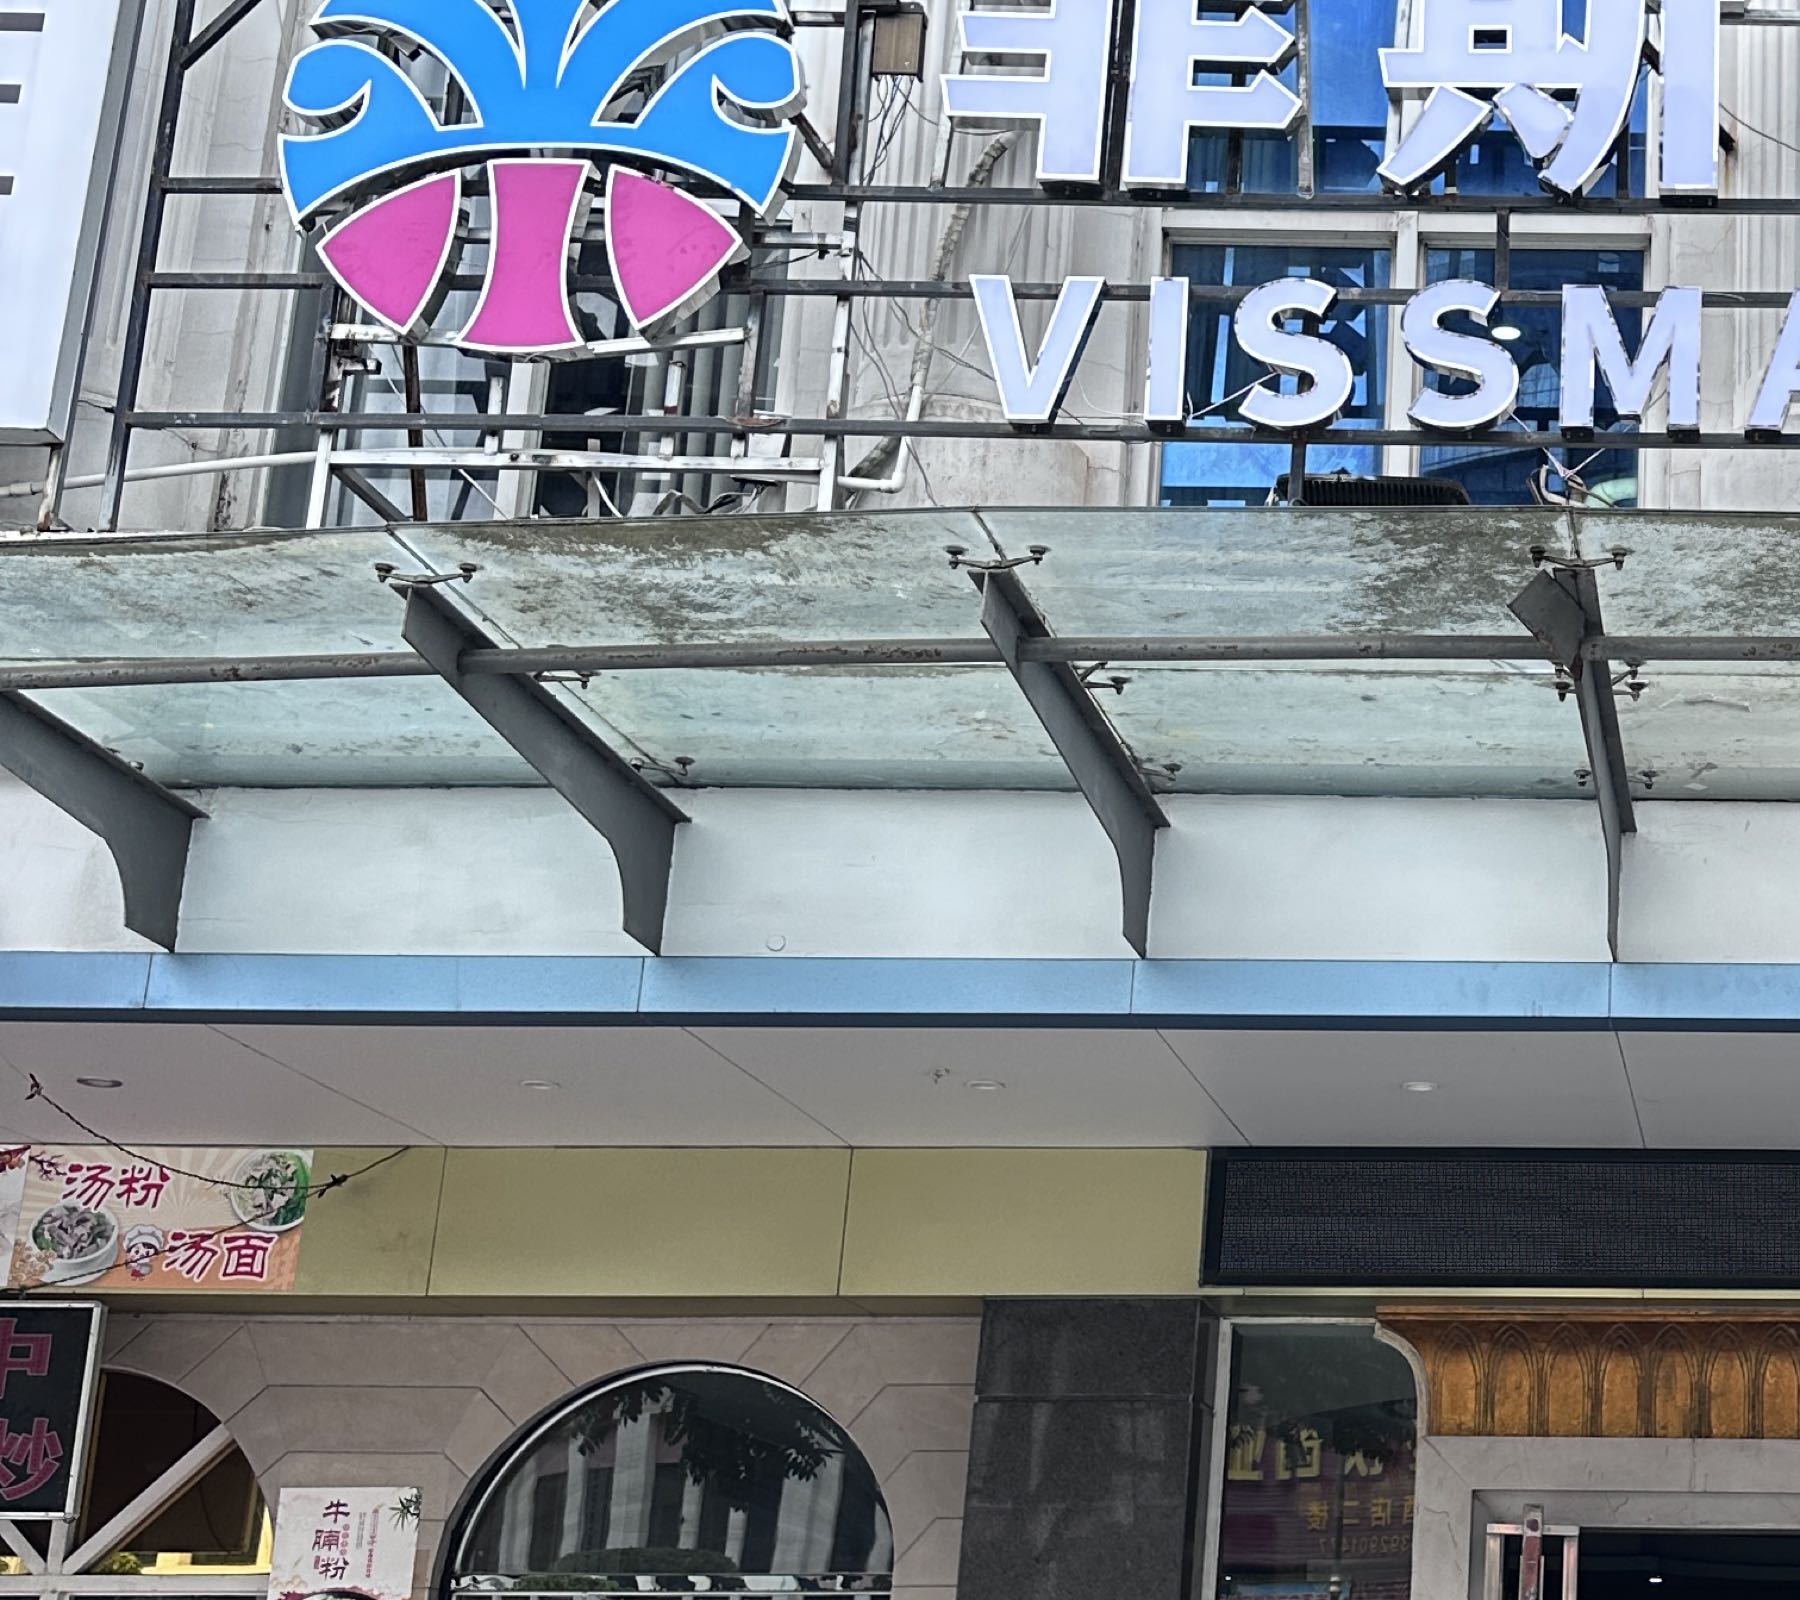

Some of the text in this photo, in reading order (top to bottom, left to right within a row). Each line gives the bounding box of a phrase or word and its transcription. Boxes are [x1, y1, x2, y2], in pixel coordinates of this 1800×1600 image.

[62, 1163, 170, 1210] 汤粉
[162, 1231, 278, 1282] 汤面
[311, 1498, 350, 1581] 牛腩粉
